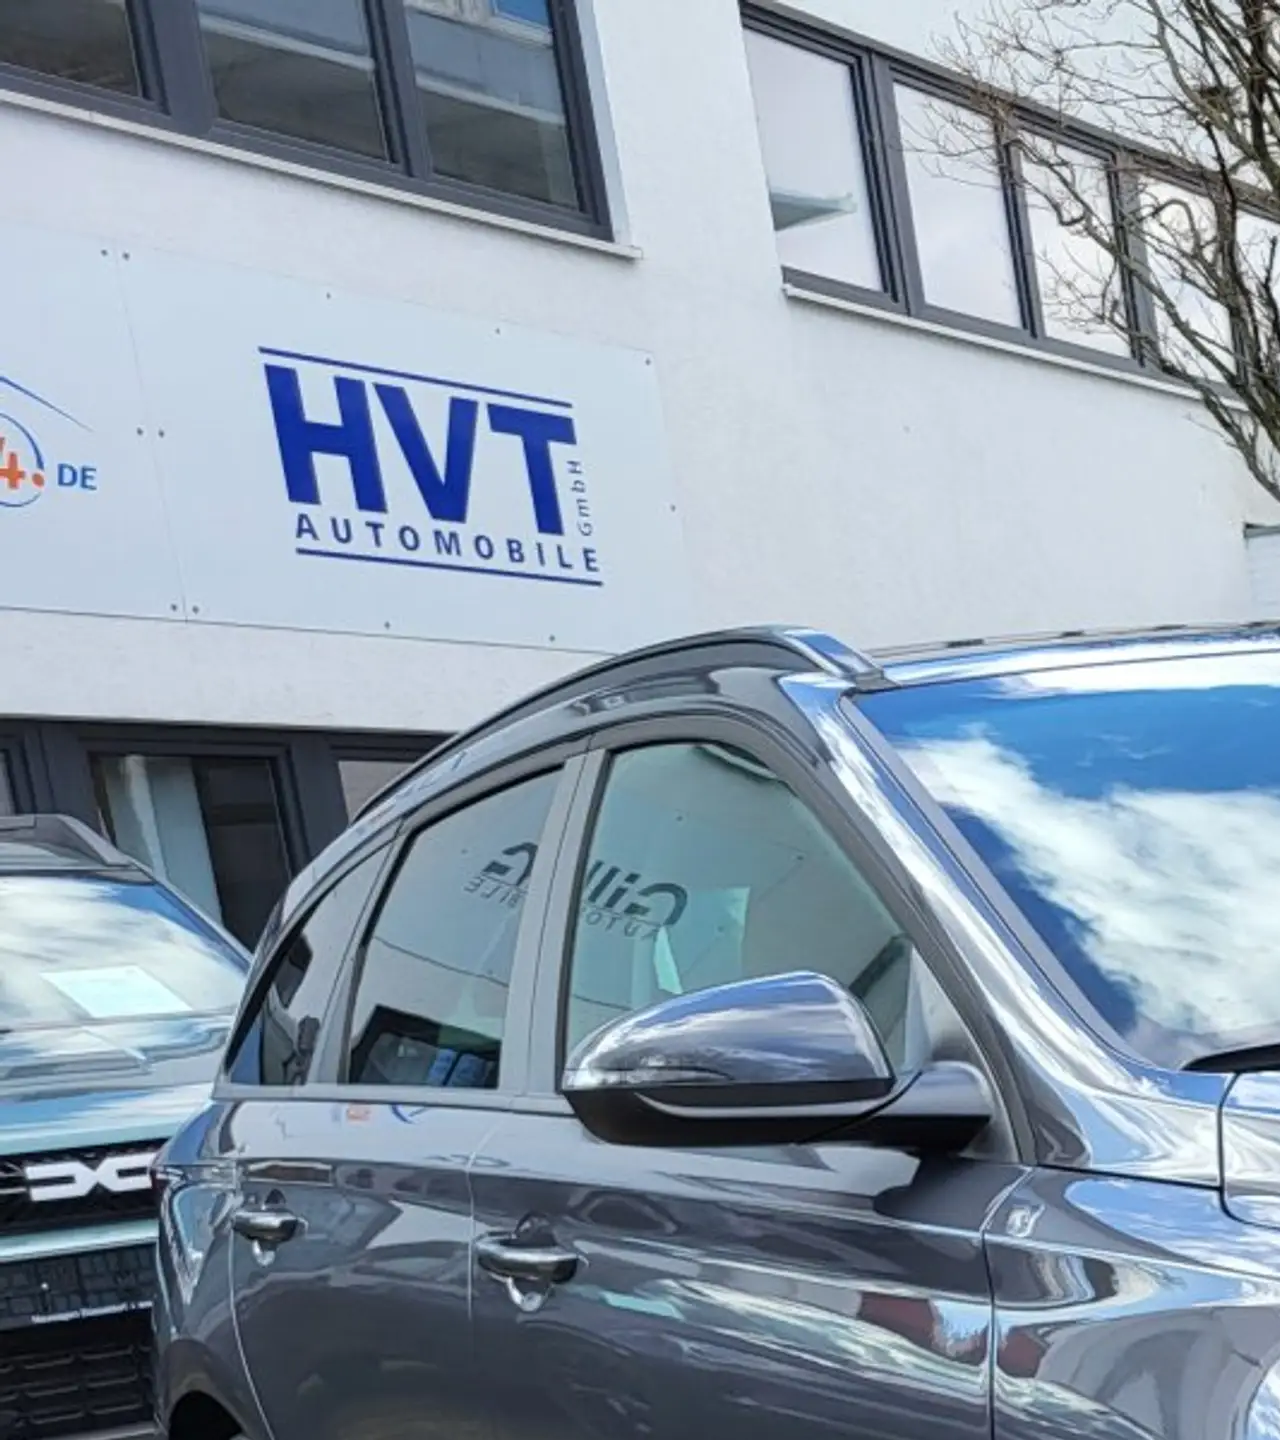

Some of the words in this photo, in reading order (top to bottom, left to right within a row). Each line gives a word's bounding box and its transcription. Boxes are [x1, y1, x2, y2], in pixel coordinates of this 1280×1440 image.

[57, 463, 98, 491] DE
[264, 363, 577, 537] HVT
[566, 460, 593, 537] GmbH
[295, 513, 600, 573] AUTOMOBILE
